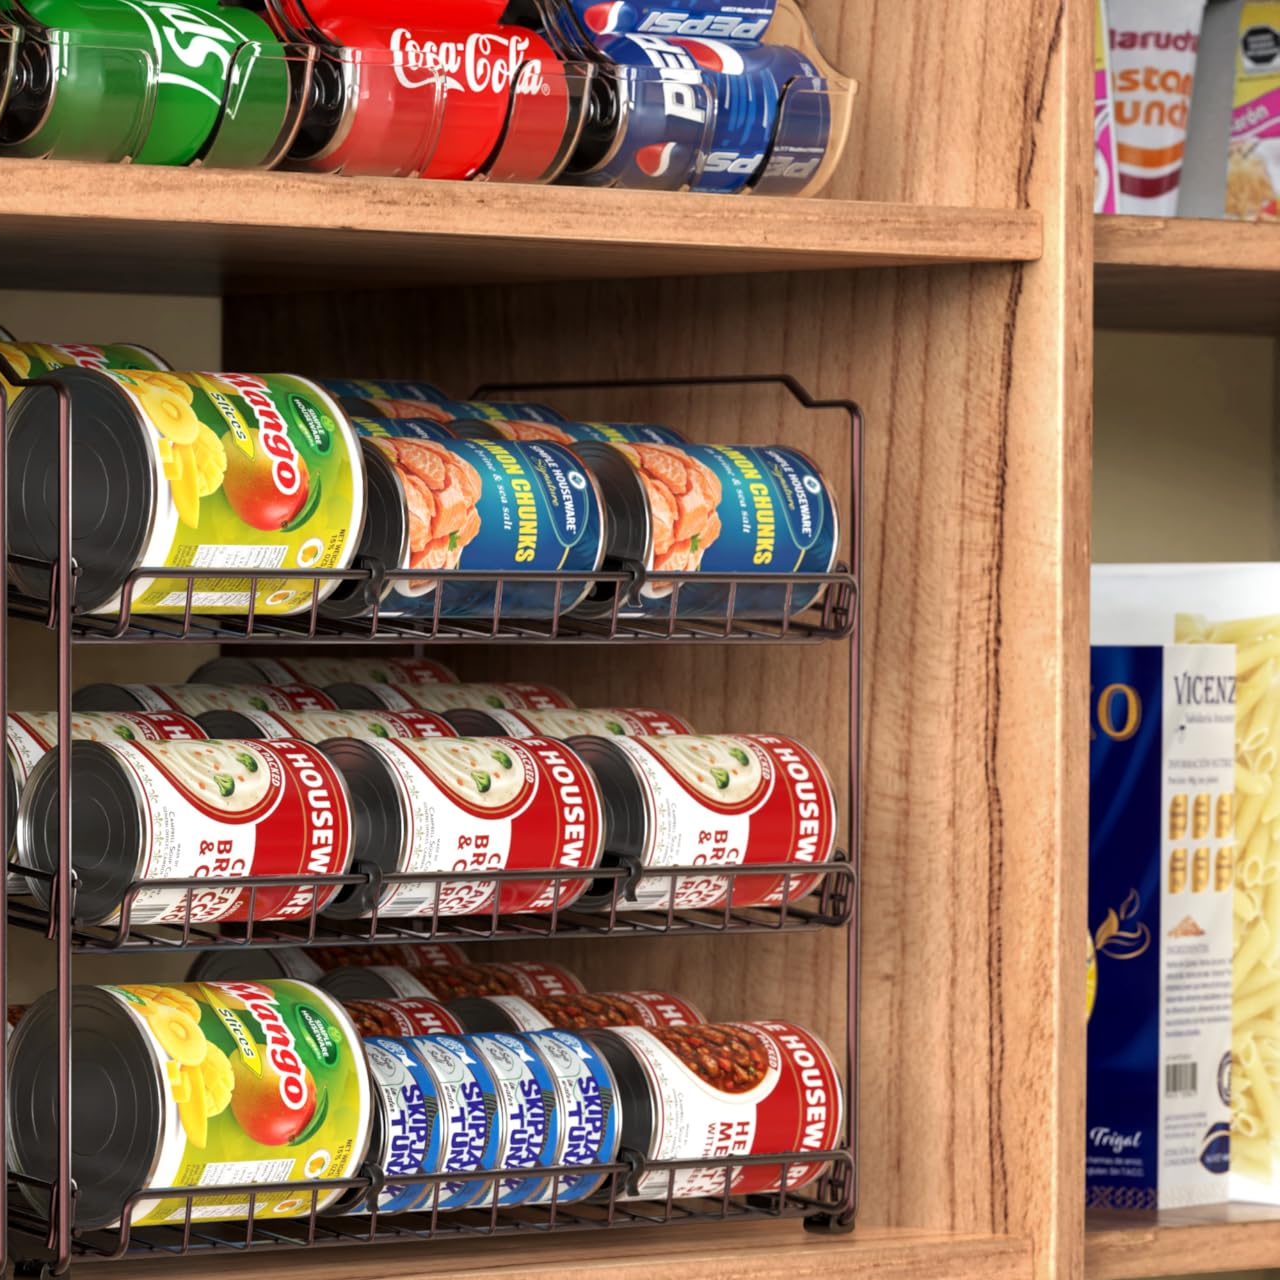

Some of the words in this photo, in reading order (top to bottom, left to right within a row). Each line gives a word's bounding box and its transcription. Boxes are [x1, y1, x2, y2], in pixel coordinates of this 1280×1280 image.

[638, 11, 770, 39] PEPSI
[390, 28, 543, 96] Coca-Cola
[209, 392, 247, 441] Slices
[211, 373, 299, 493] Mango
[294, 398, 322, 446] HOUSEWARE
[305, 406, 325, 435] SIMPLE
[496, 483, 509, 504] sea
[503, 505, 513, 530] salt
[529, 444, 553, 471] SIMPLE
[552, 468, 577, 532] HOUSEWARE
[736, 488, 747, 508] sea
[742, 509, 751, 534] salt
[788, 474, 812, 536] HOUSEWARE
[511, 479, 538, 563] CHUNKS
[749, 483, 776, 566] CHUNKS
[263, 752, 280, 787] PACKED
[518, 749, 535, 784] PACKED
[199, 839, 214, 856] &
[458, 834, 472, 850] &
[215, 982, 307, 1109] Mango
[217, 1008, 255, 1057] Slices
[301, 1010, 329, 1058] HOUSEWARE
[314, 1018, 332, 1047] SIMPLE
